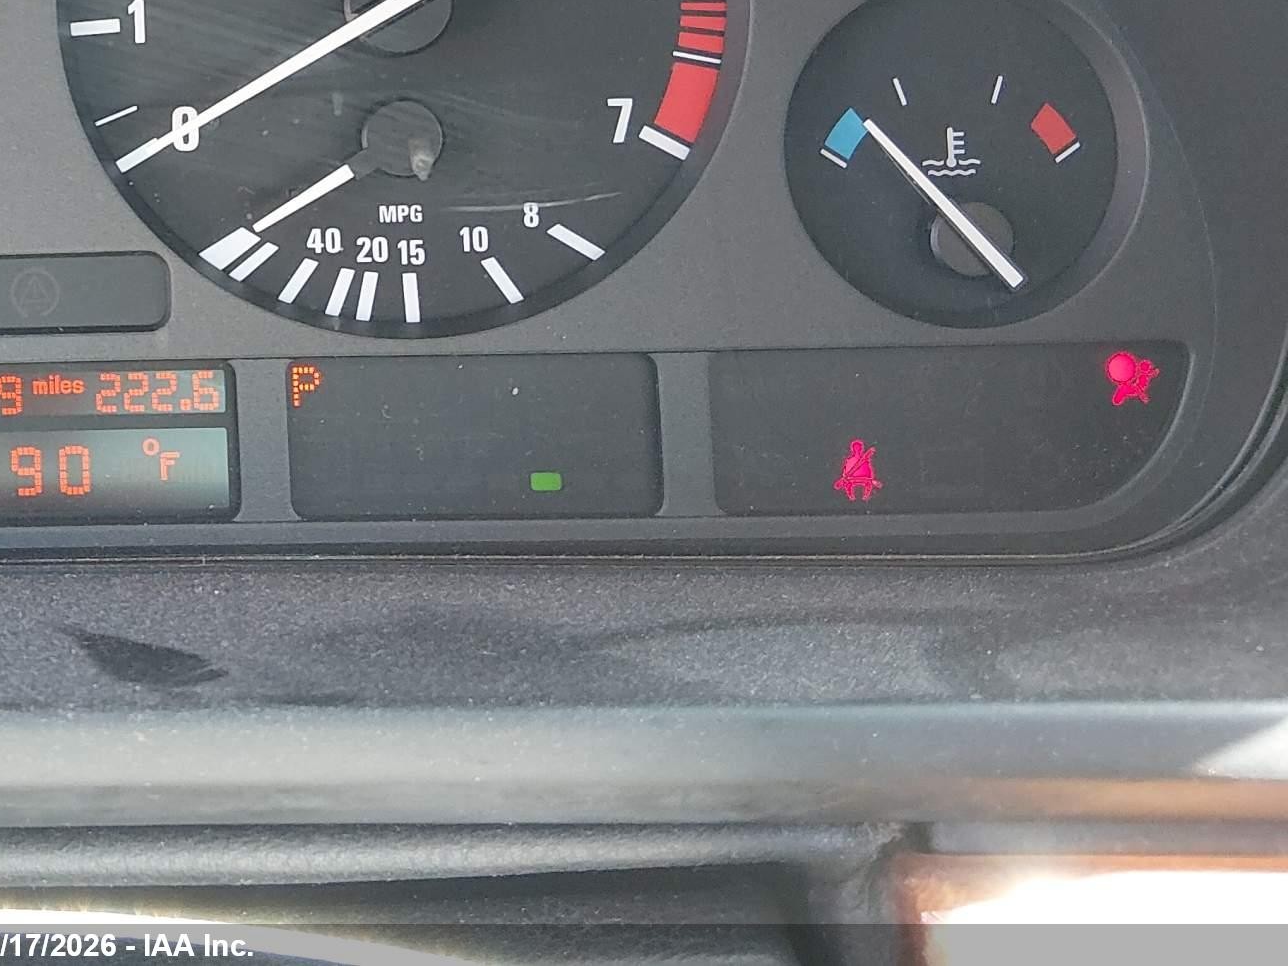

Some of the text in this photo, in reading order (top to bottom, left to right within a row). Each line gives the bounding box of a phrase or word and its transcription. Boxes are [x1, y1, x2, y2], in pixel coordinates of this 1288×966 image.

[128, 0, 146, 43] 1
[171, 105, 200, 152] 0
[607, 98, 634, 143] 7
[378, 205, 423, 224] MPG
[523, 203, 540, 228] 8
[306, 229, 341, 254] 40
[356, 238, 389, 263] 20
[398, 240, 426, 265] 15
[460, 227, 489, 251] 10
[32, 376, 85, 396] miles
[96, 371, 219, 413] 222.6
[291, 365, 322, 407] P
[11, 445, 90, 496] 90
